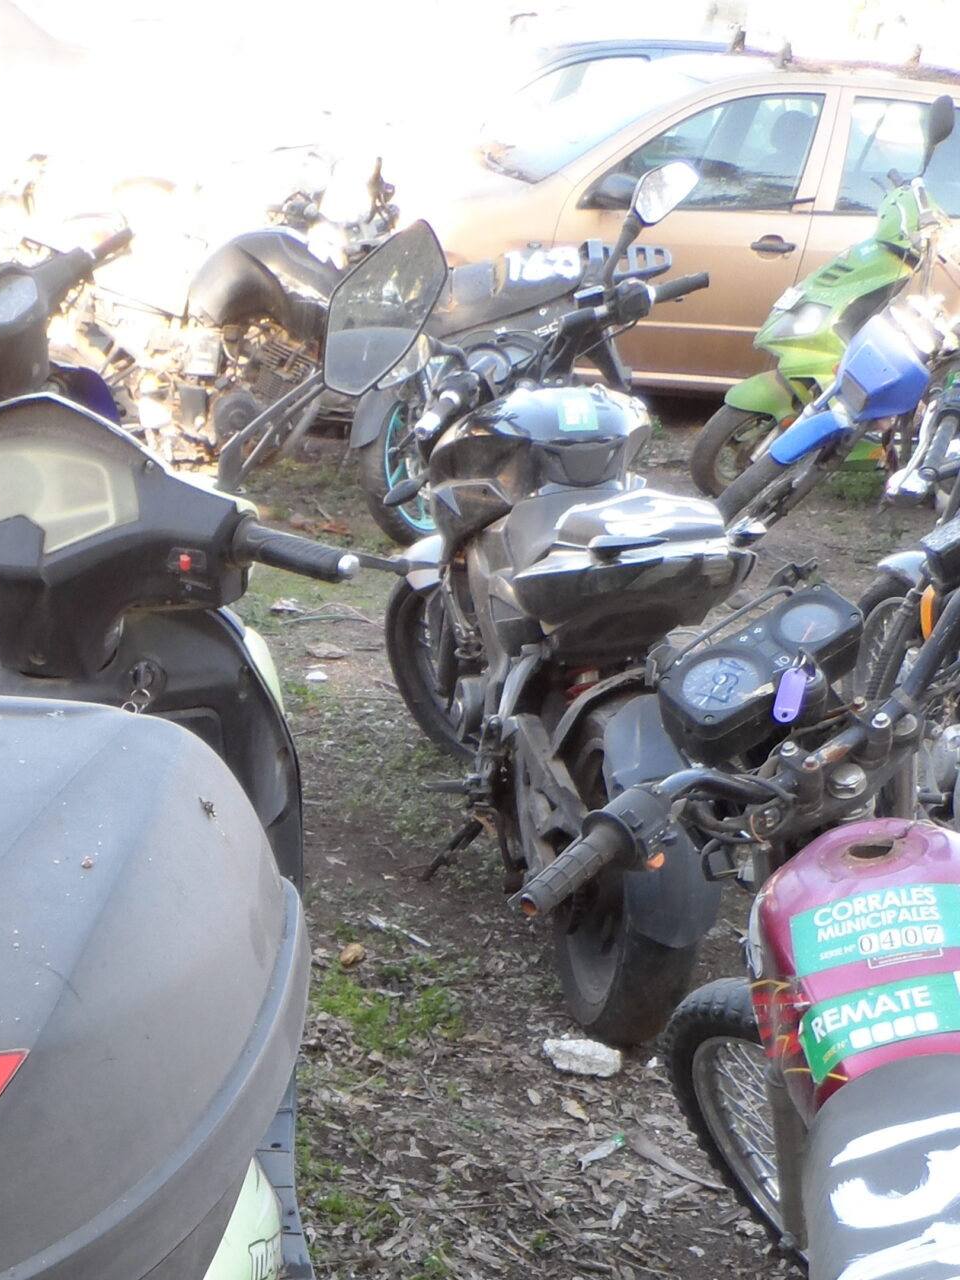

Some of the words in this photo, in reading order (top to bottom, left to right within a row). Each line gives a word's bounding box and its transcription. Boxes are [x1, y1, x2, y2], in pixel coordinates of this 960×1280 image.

[813, 886, 938, 927] CORRALES
[817, 905, 941, 943] MUNICIPALES
[859, 925, 939, 953] 0407
[810, 985, 932, 1044] REMATE
